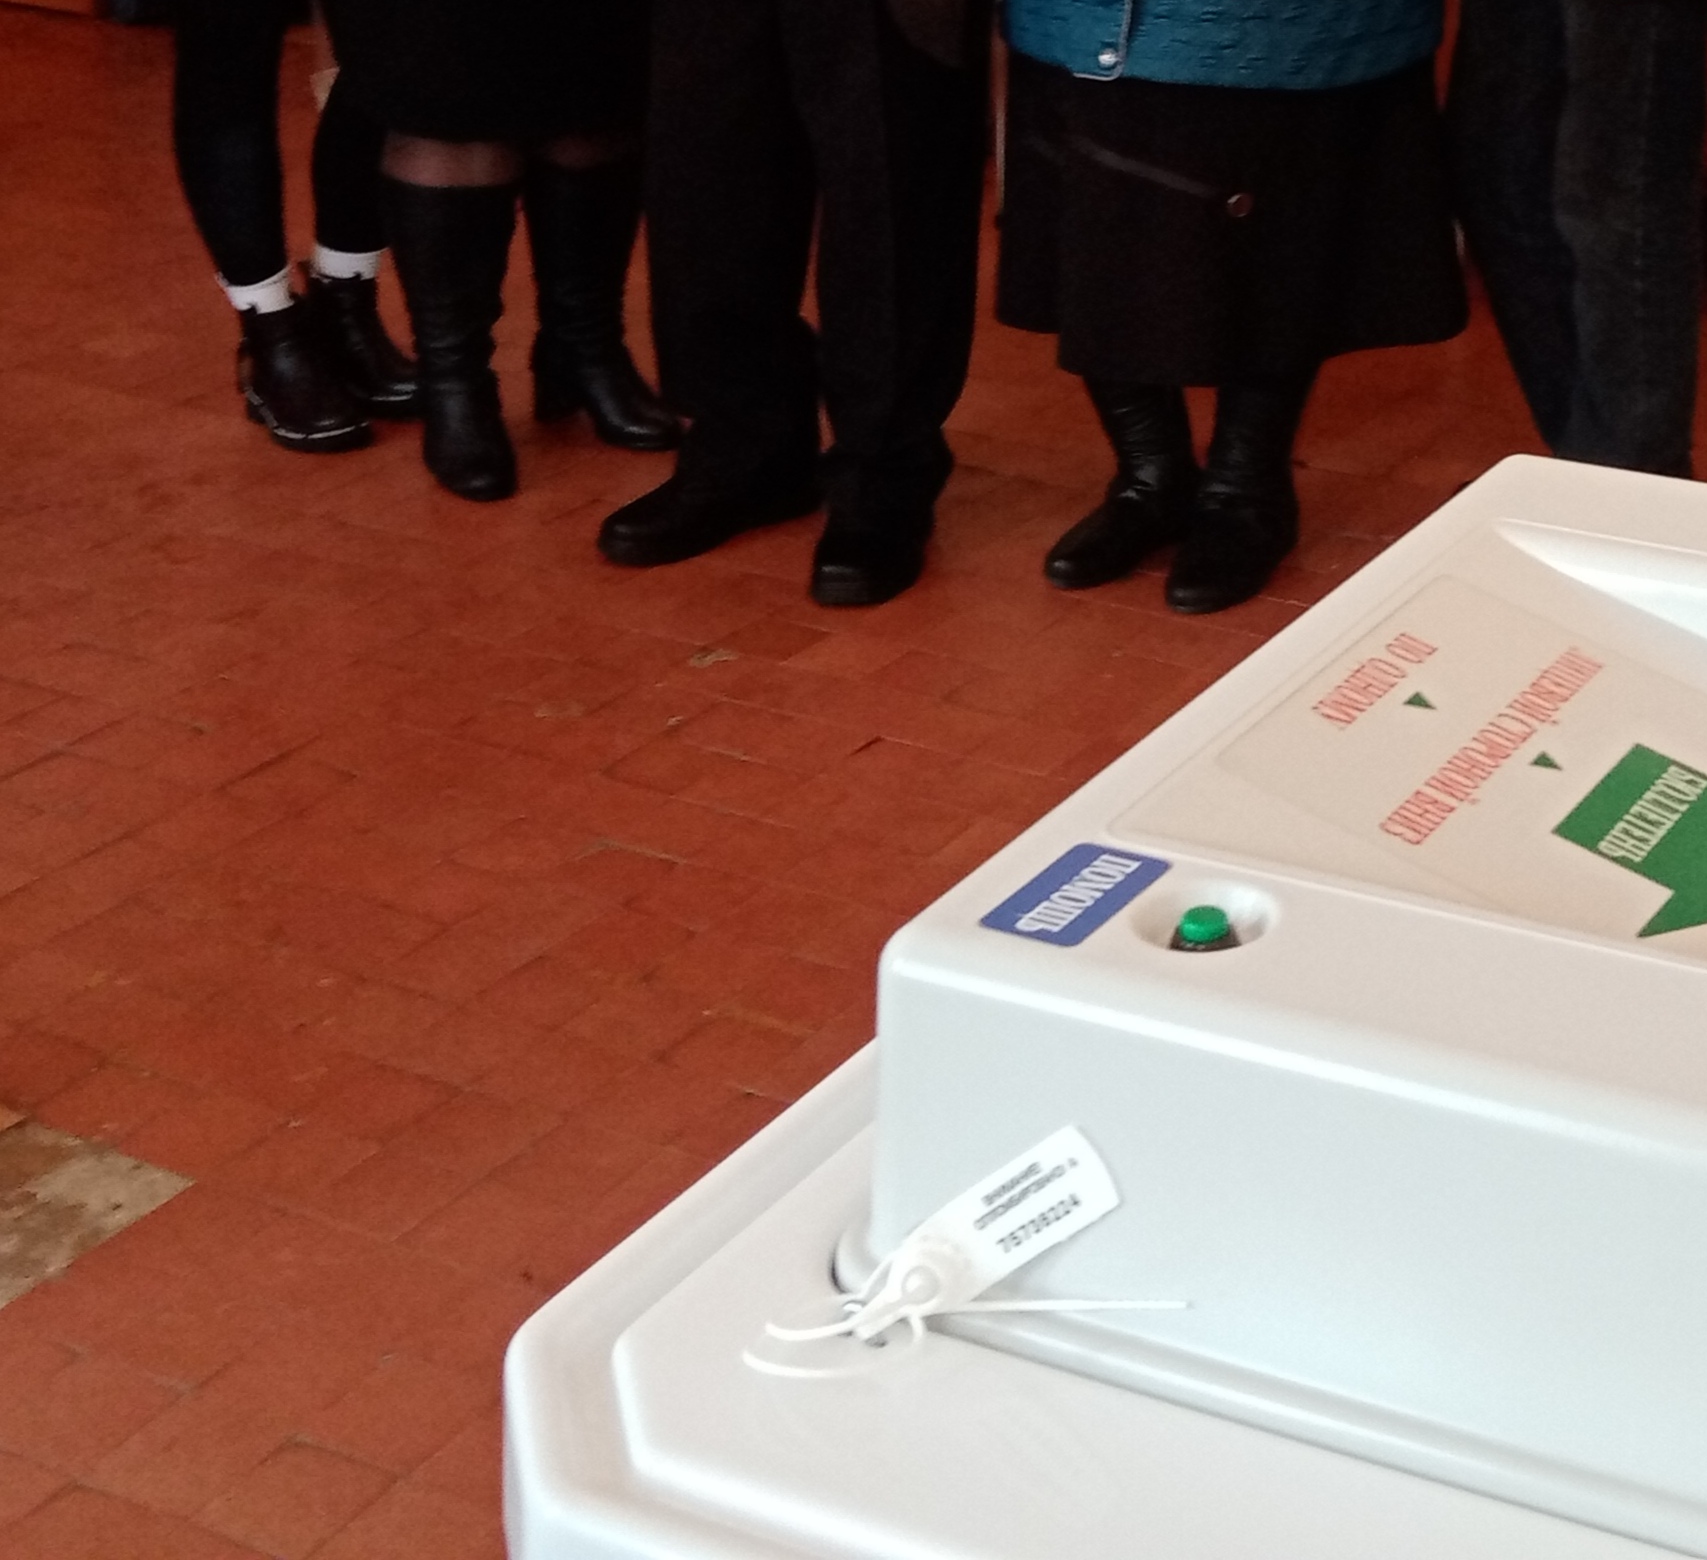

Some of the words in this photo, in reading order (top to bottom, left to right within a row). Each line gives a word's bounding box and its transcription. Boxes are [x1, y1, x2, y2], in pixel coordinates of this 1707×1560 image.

[1386, 633, 1439, 664] ПО
[1312, 657, 1407, 727] ОДНОМУ
[1425, 712, 1537, 805] СТОРОНОЙ
[1379, 790, 1456, 846] ВНИЗ
[1015, 853, 1142, 933] ПОМОЩЬ
